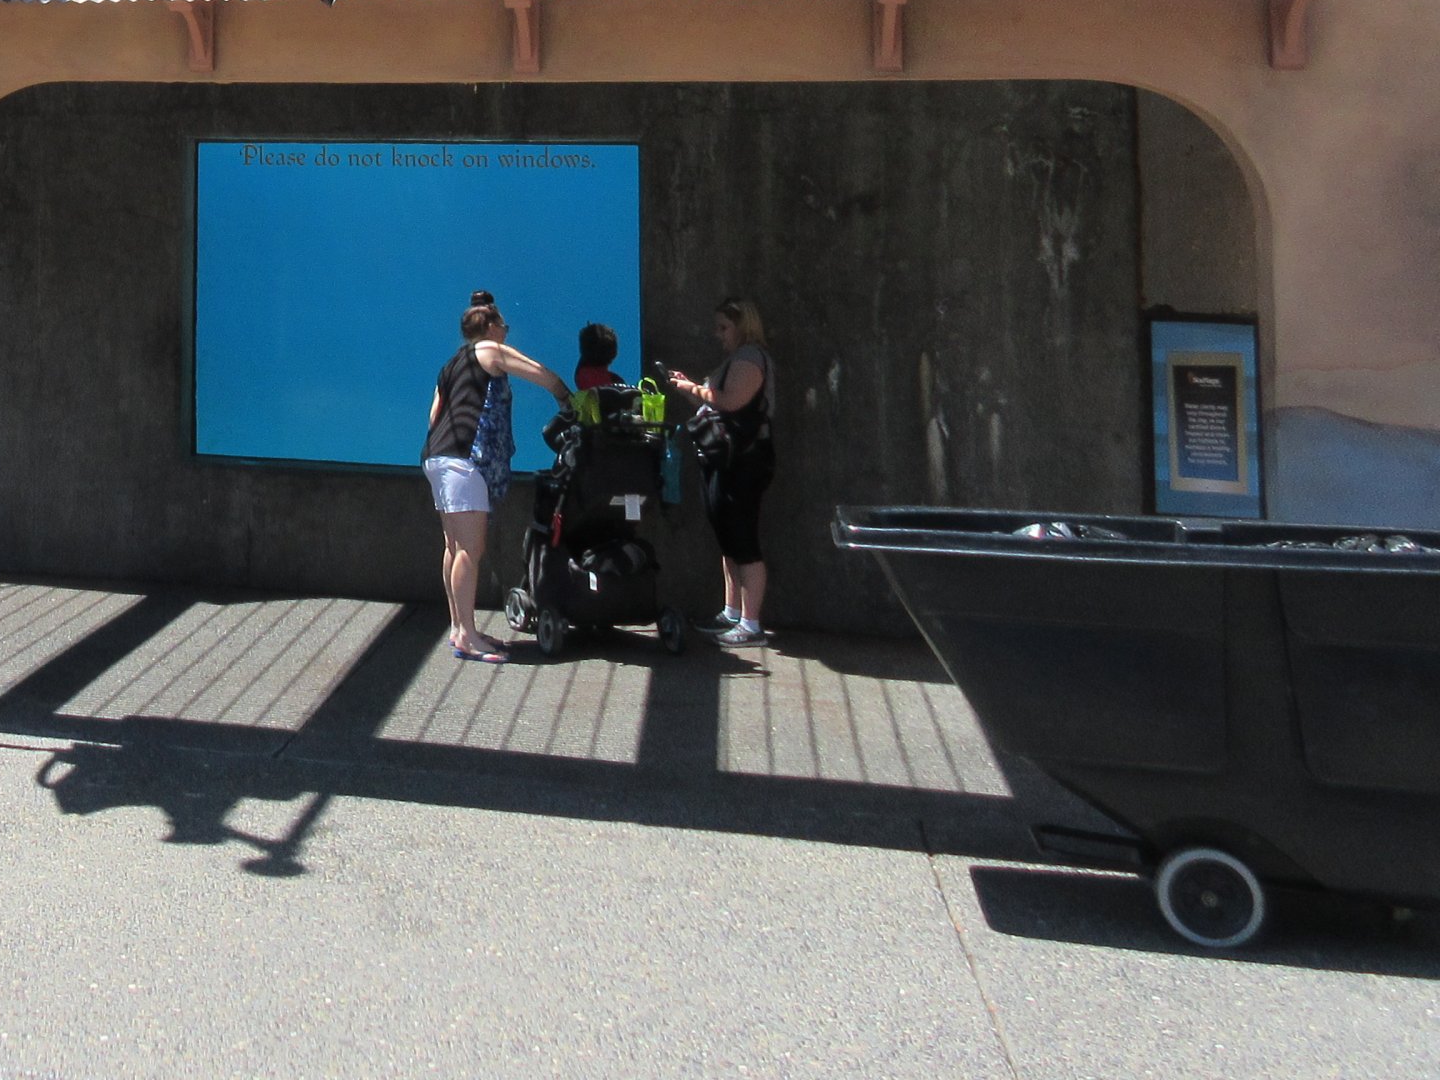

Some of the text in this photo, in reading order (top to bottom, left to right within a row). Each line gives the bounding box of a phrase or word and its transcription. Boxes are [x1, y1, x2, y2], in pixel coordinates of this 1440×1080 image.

[240, 143, 596, 167] Please do not knock on windows.
